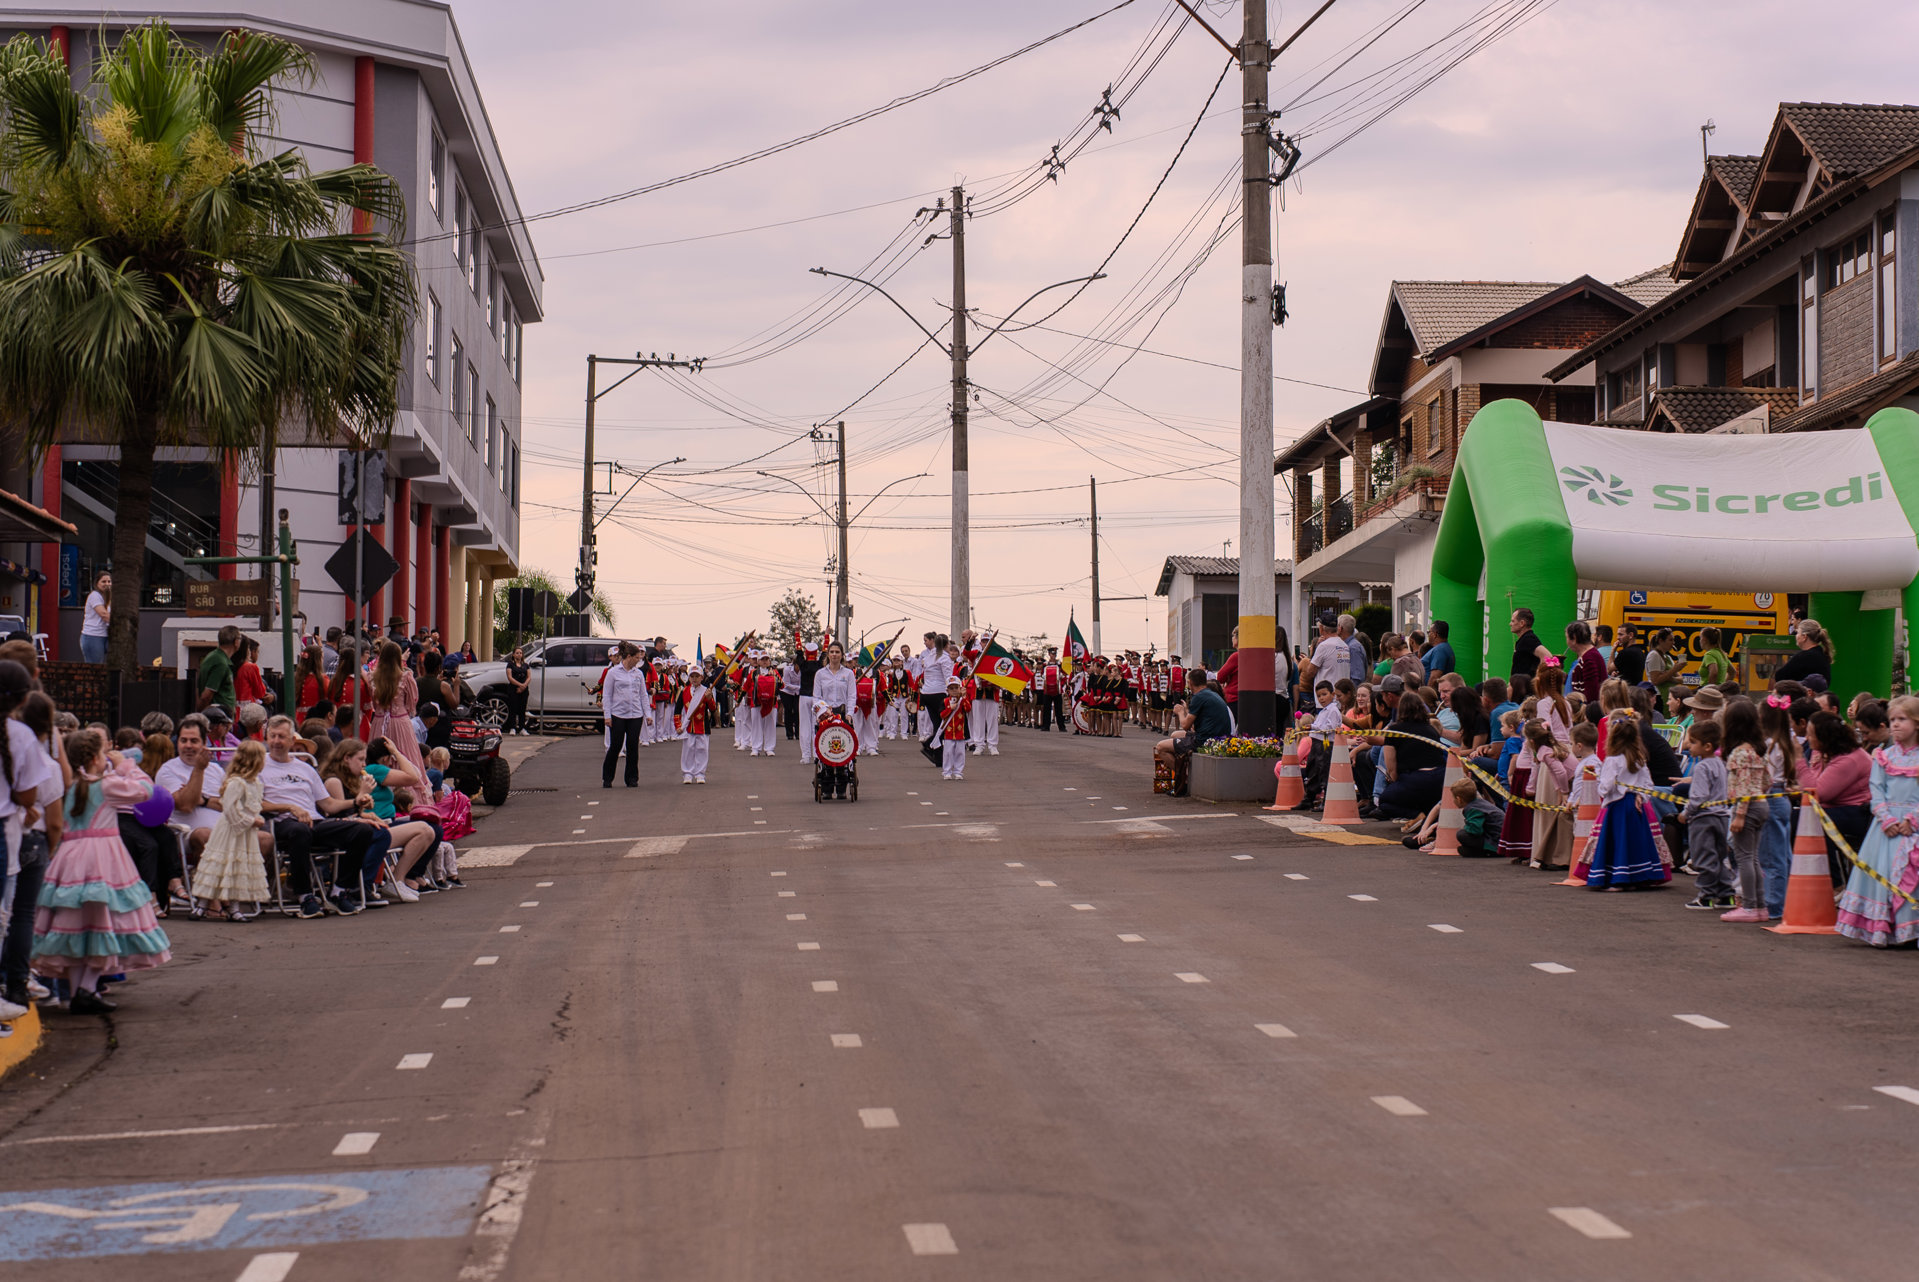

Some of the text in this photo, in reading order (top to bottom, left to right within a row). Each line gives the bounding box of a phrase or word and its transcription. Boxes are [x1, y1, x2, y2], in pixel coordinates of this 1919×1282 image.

[1652, 471, 1883, 514] Sicredi
[61, 553, 71, 587] pepsi
[190, 584, 209, 594] RUA
[195, 594, 259, 607] SÃO PEDRO
